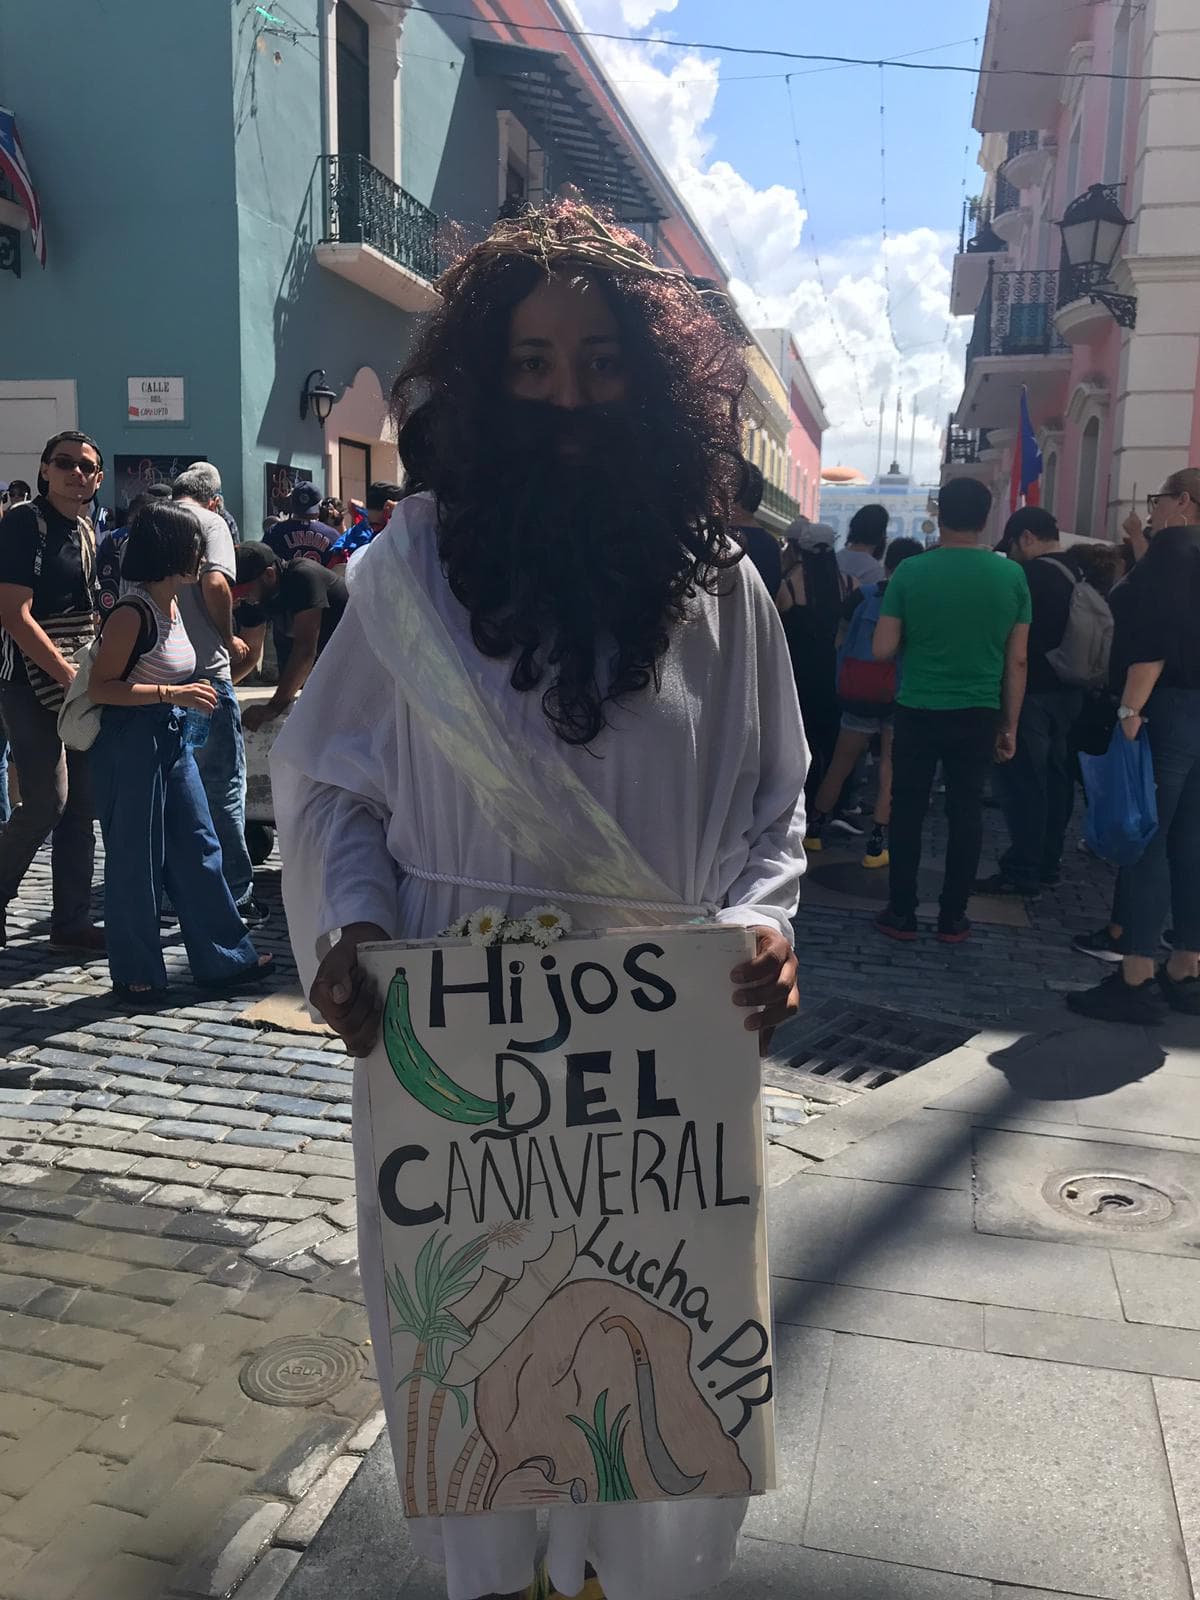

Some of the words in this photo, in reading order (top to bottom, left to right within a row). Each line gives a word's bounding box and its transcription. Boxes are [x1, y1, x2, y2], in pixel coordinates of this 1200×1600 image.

[141, 381, 170, 393] CALLE
[284, 530, 330, 553] LINDOR
[429, 942, 677, 1053] Hijos
[495, 1049, 681, 1131] DEL
[378, 1121, 750, 1227] CAÑAVERAL
[577, 1217, 714, 1333] Lucha
[279, 1365, 323, 1377] AGUA
